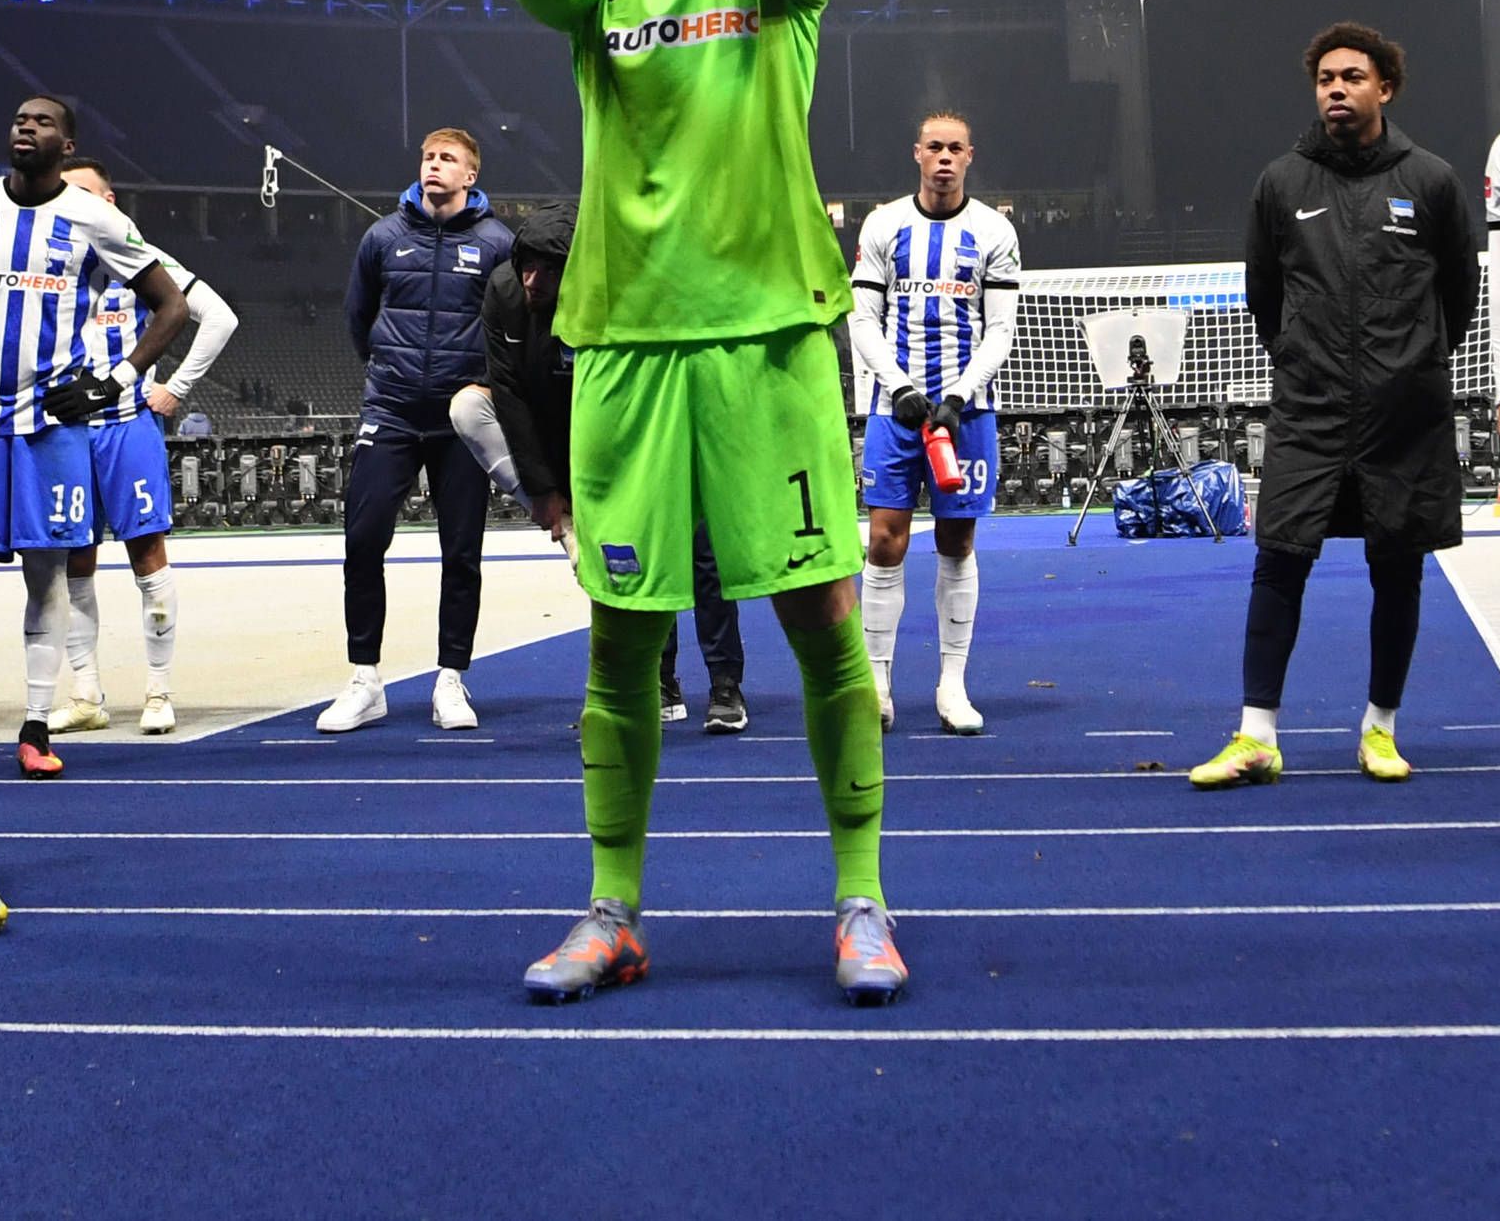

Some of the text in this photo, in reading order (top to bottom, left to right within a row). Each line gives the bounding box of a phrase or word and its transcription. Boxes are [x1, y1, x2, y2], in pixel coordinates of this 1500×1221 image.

[893, 281, 977, 296] AUTOHERO
[95, 312, 128, 326] ERO
[955, 458, 989, 496] 39
[48, 484, 86, 524] 18
[133, 479, 154, 515] 5
[787, 469, 825, 539] 1
